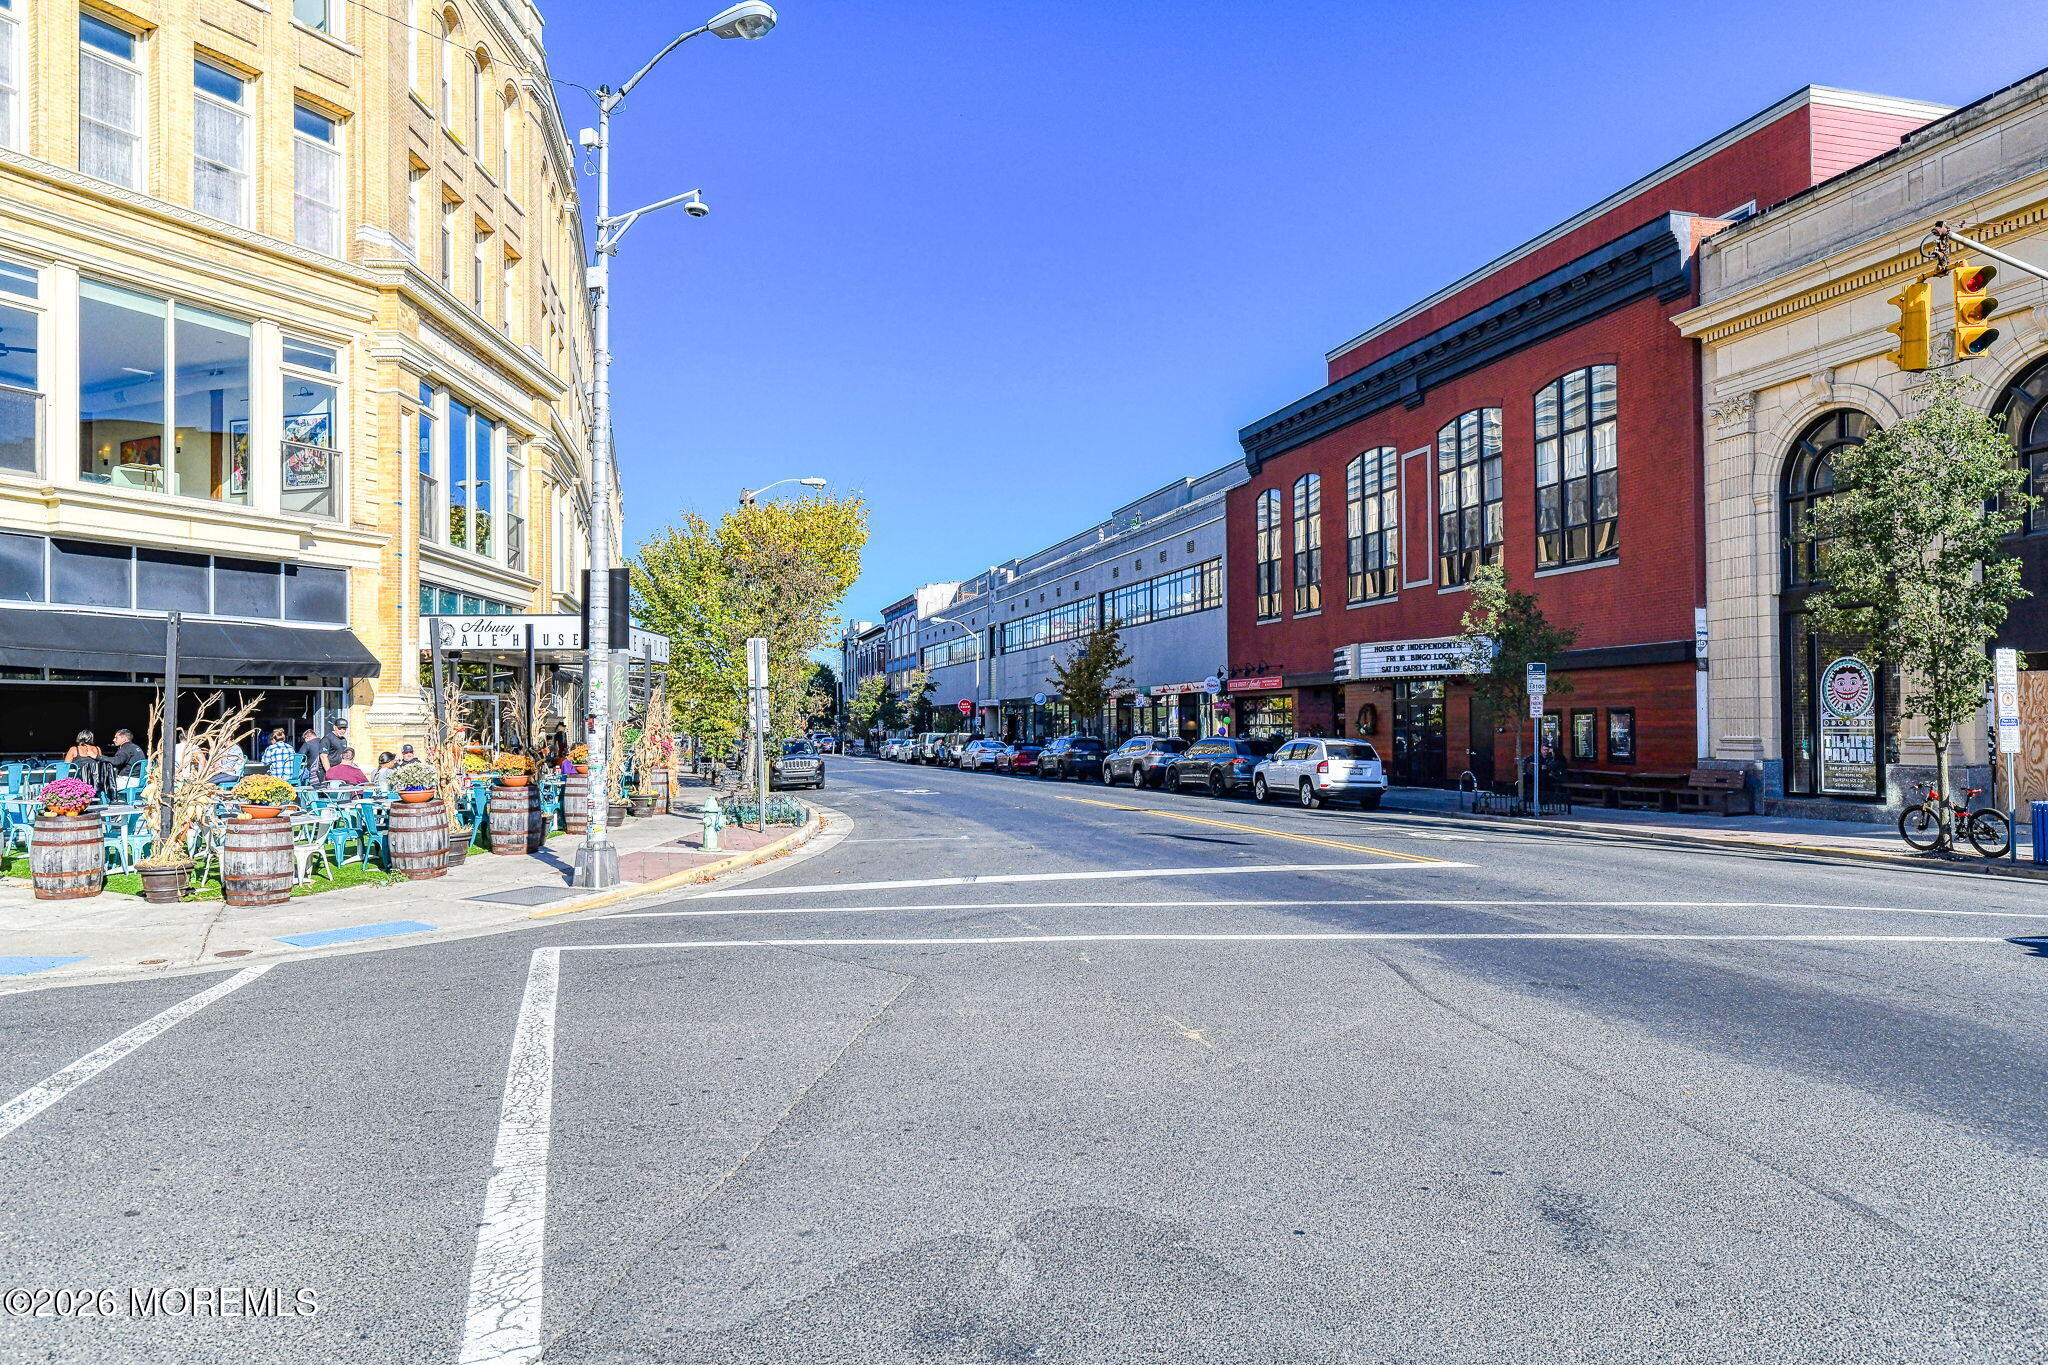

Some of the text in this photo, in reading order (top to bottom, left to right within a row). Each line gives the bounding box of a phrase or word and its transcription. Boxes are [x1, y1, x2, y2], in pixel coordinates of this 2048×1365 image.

[461, 618, 514, 636] Asbury
[461, 633, 580, 647] ALE HUSE
[1374, 645, 1395, 653] HOUSE
[1407, 642, 1462, 651] INDEPENDENTS
[1410, 653, 1431, 661] BINGO
[1433, 652, 1454, 661] LOCO
[1381, 665, 1392, 673] SAT
[1393, 665, 1400, 673] 19
[1824, 736, 1873, 748] TILLIE'S
[1825, 748, 1873, 761] PALACE
